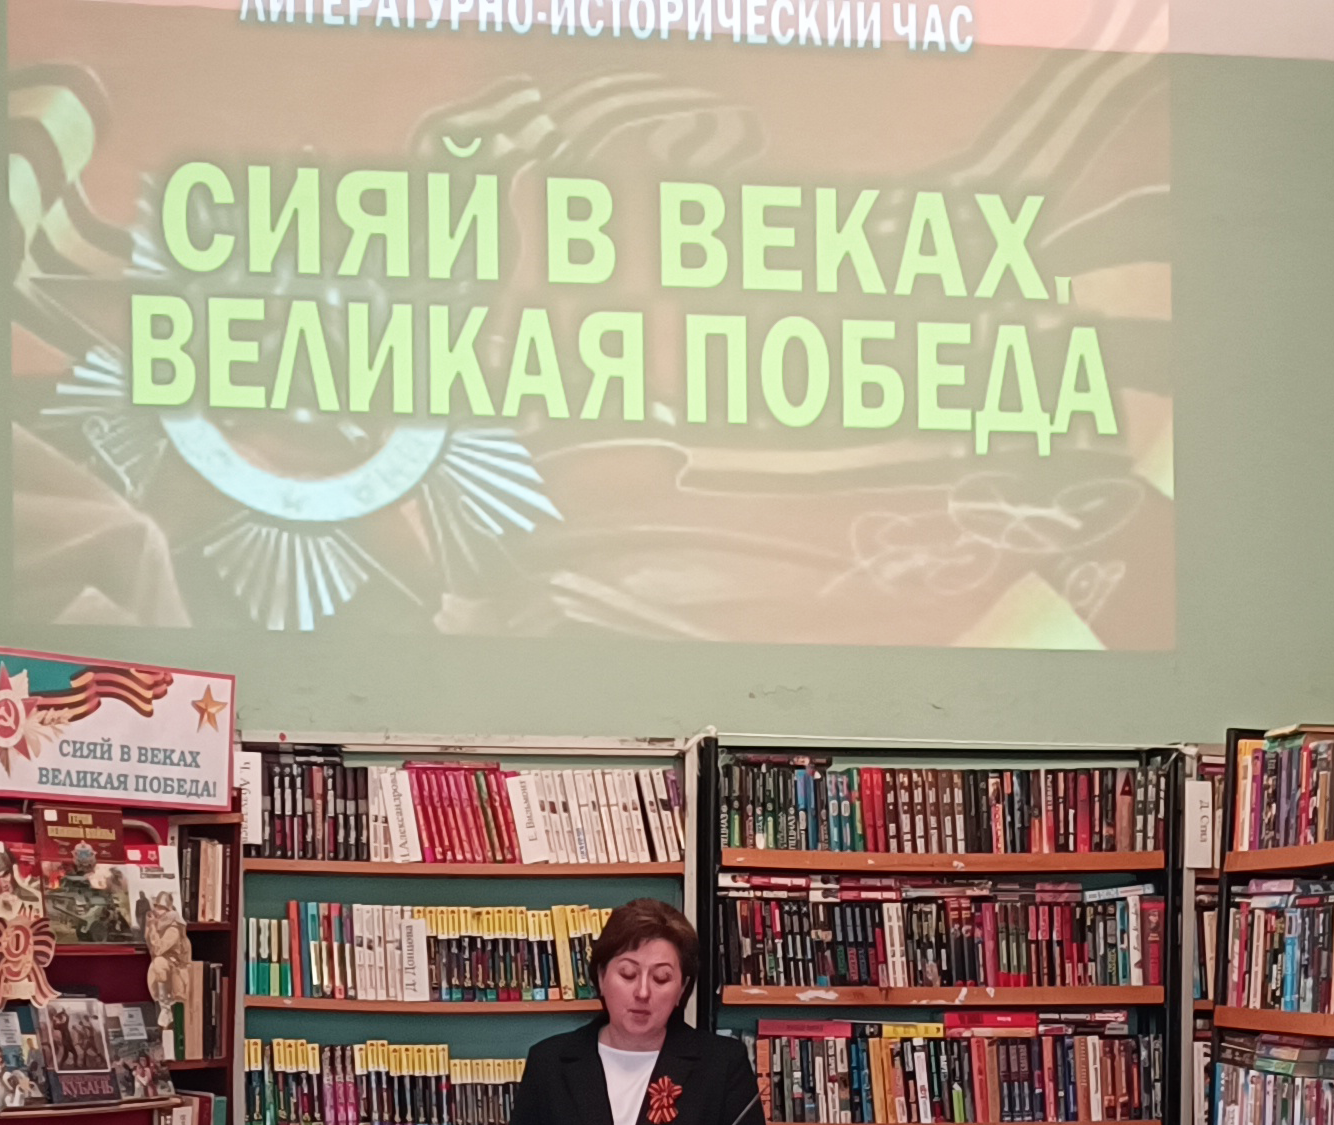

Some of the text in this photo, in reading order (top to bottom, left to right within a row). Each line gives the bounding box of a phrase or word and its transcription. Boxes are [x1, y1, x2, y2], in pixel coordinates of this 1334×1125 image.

[239, 0, 974, 52] ЛИТЕРАТУРНО-ИСТОРИЧЕСКИЙ ЧАС
[161, 134, 1074, 304] СИЯЙ В ВЕКАХ,
[131, 293, 1120, 457] ВЕЛИКАЯ ПОБЕДА
[58, 737, 201, 768] СИЯЙ В ВЕКАХ
[37, 766, 217, 799] ВЕЛИКАЯ ПОБЕДА!
[519, 780, 537, 829] Вильмонт
[1199, 814, 1209, 843] Стил
[404, 924, 416, 979] Донцова
[61, 1079, 115, 1096] КУБАНЬ
